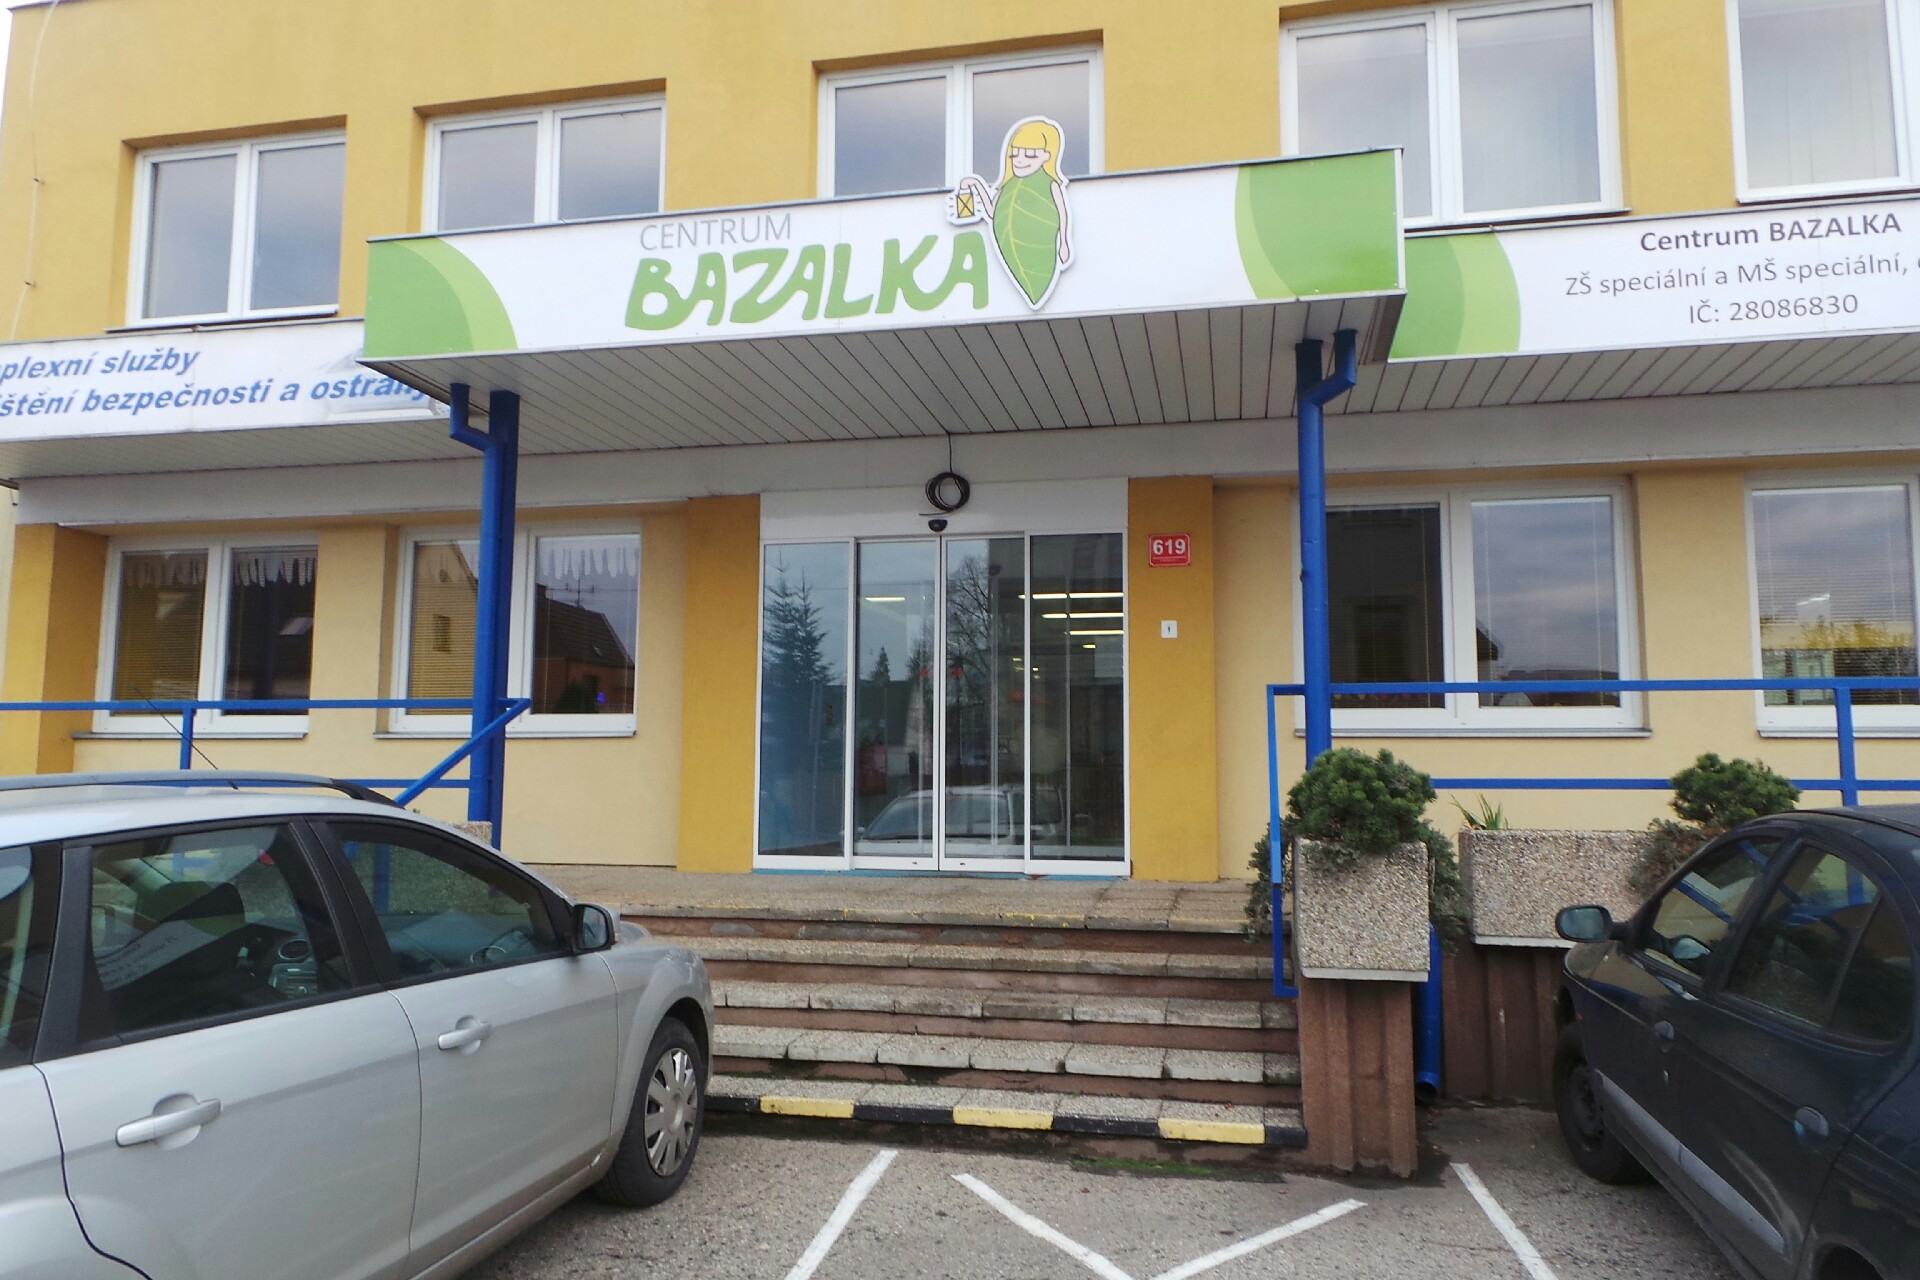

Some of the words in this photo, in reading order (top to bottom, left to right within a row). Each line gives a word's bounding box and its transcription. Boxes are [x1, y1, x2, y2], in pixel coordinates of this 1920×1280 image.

[640, 213, 792, 251] CENTRUM
[1640, 225, 1760, 251] Centrum
[1769, 212, 1902, 242] BAZALKA
[625, 231, 989, 330] BAZALKA
[1566, 272, 1592, 296] ZŠ
[1599, 266, 1706, 298] speciální
[1715, 271, 1728, 286] a
[1738, 258, 1777, 283] MŠ
[1785, 252, 1907, 284] speciální,
[1689, 299, 1719, 324] IČ:
[1729, 294, 1858, 322] 28086830
[0, 351, 98, 386] plexní
[101, 347, 202, 376] služby
[0, 389, 79, 417] štění
[82, 378, 274, 416] bezpečnosti
[279, 380, 300, 401] a
[1152, 538, 1186, 555] 619
